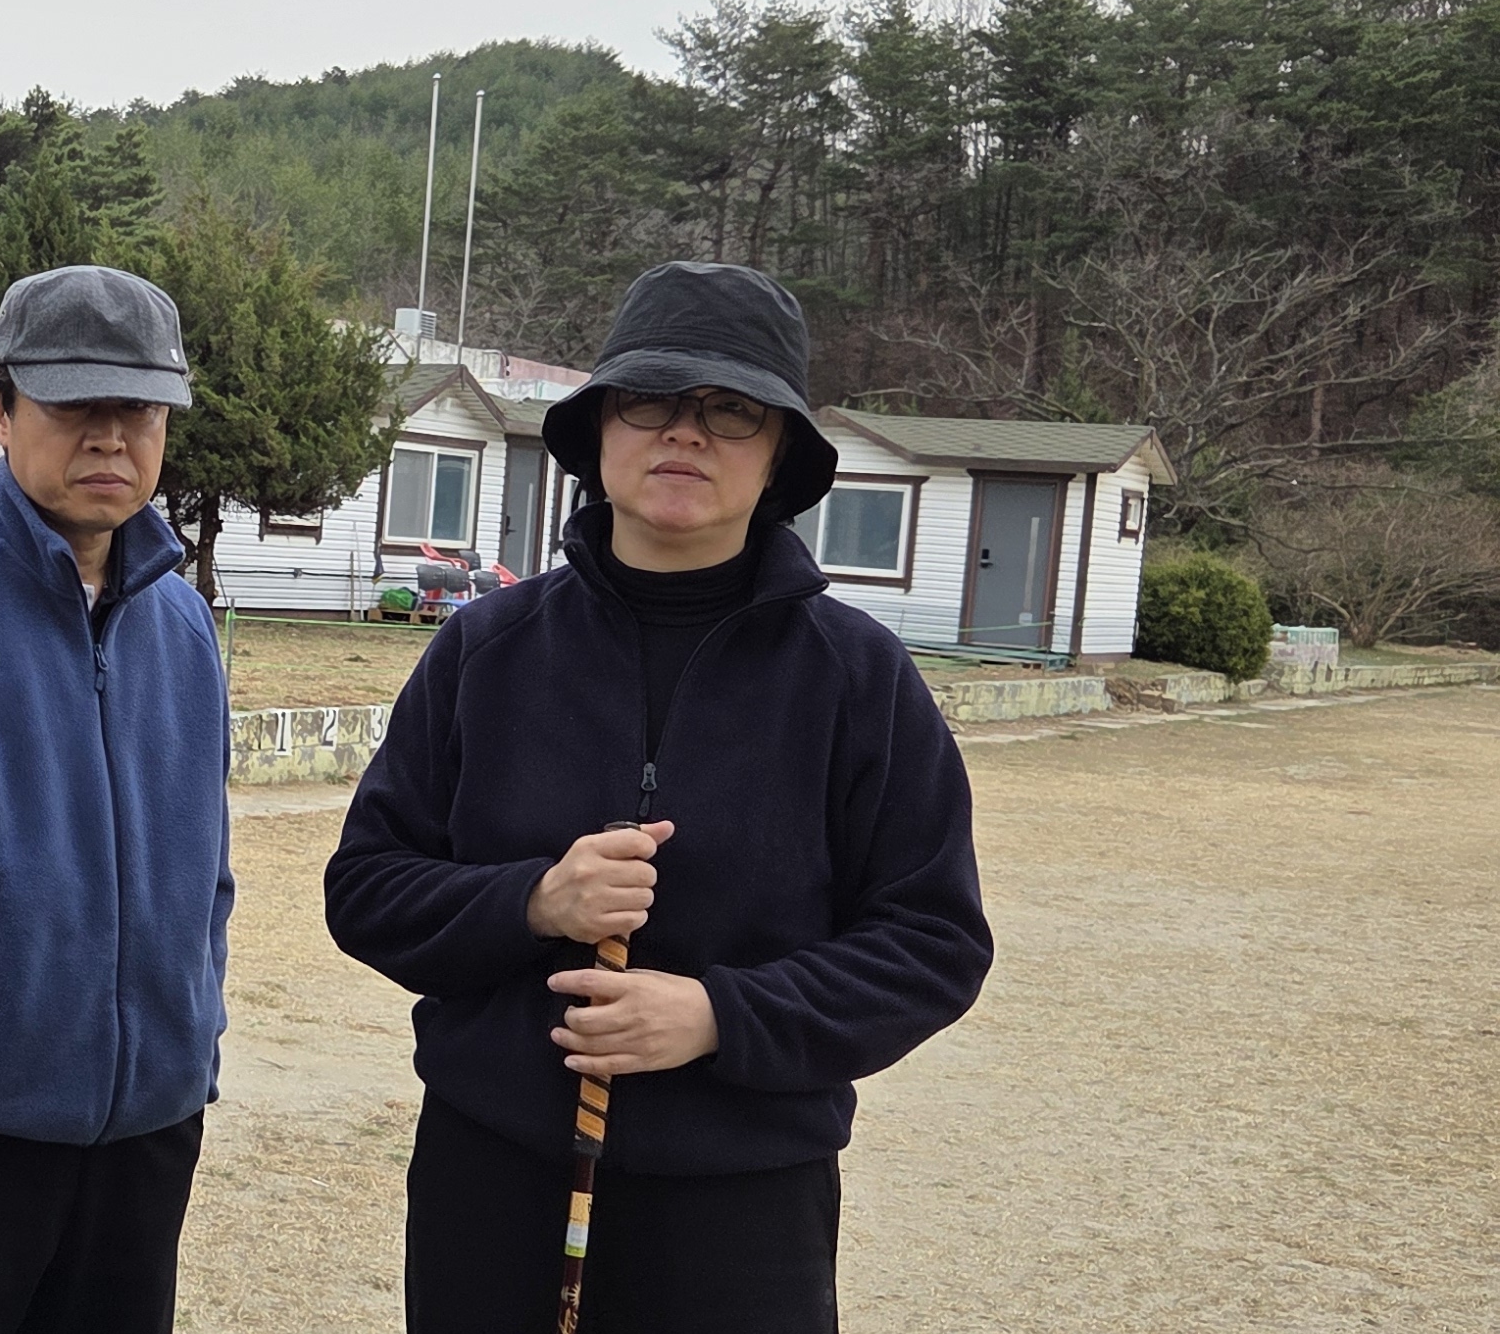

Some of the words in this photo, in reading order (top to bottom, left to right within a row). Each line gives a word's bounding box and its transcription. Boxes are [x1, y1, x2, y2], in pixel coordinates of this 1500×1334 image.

[276, 712, 286, 751] 1
[321, 709, 336, 746] 2
[371, 708, 384, 742] 3
